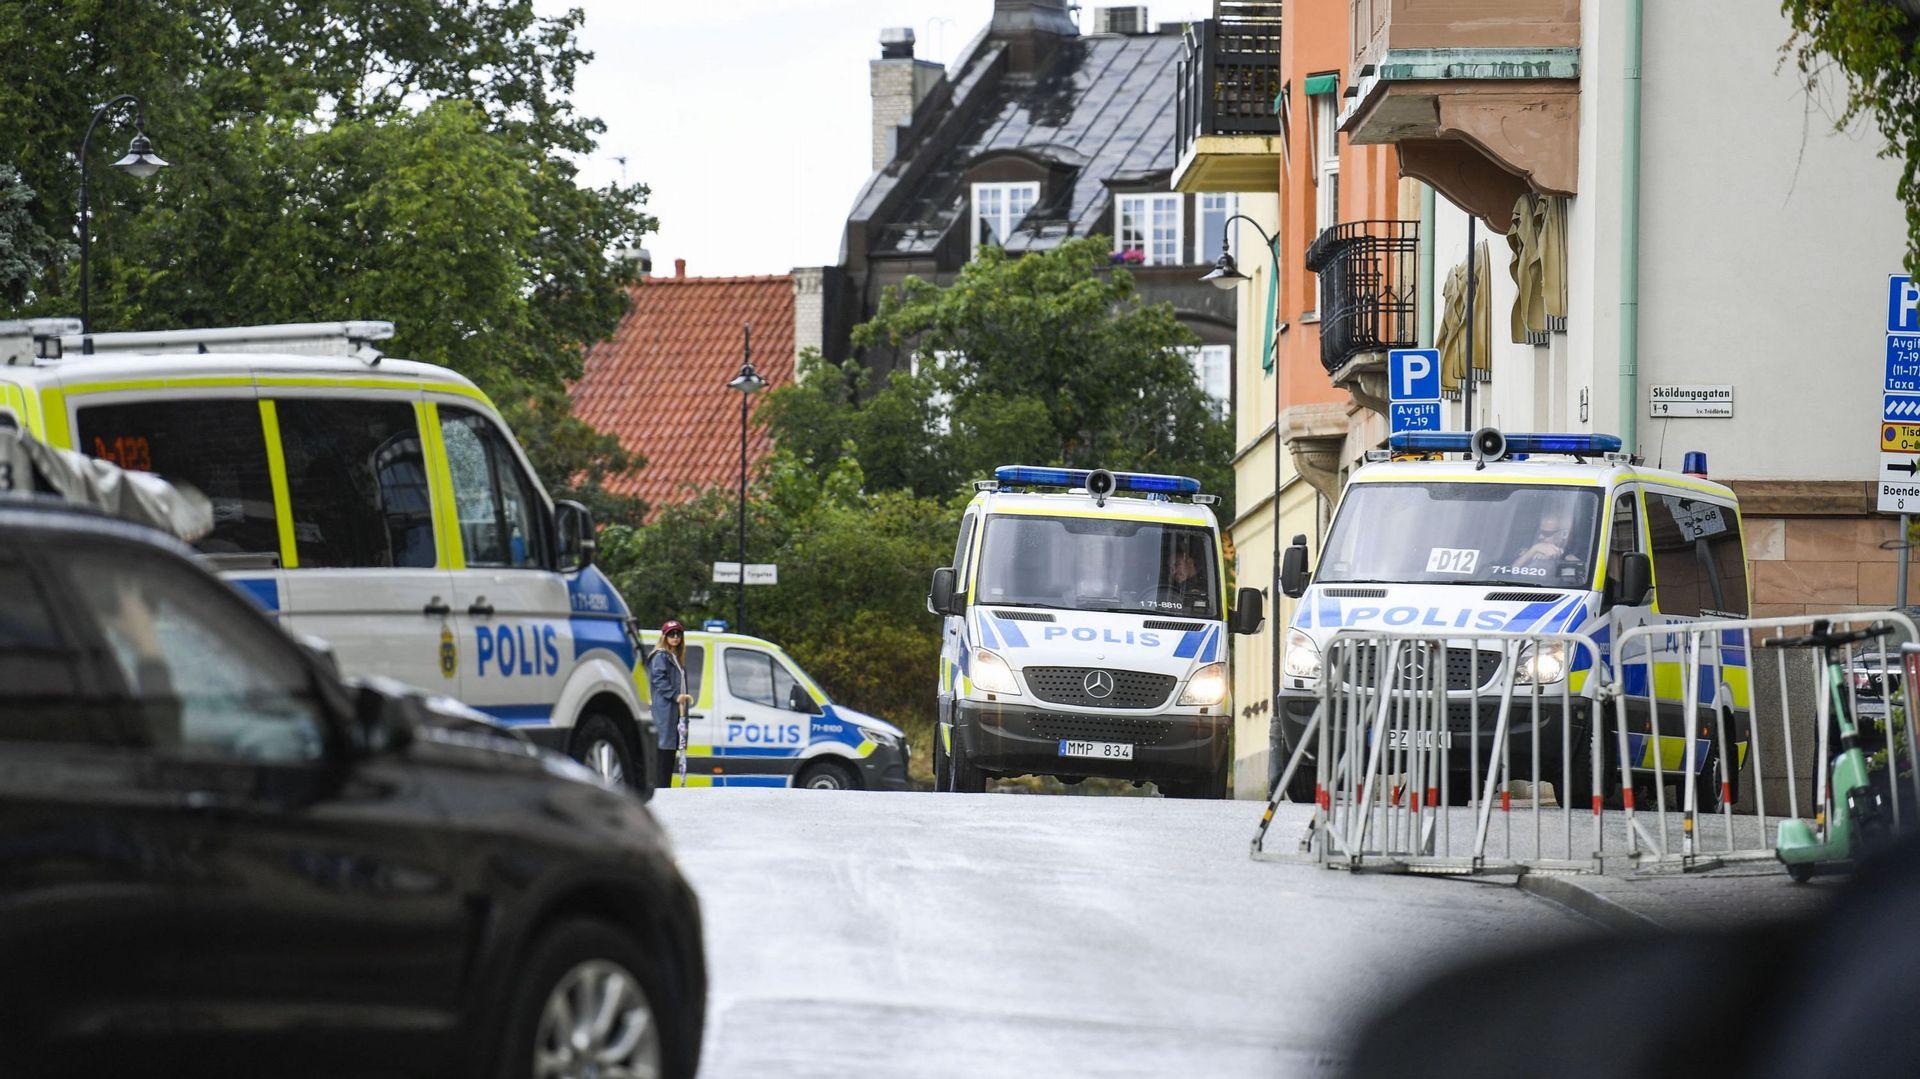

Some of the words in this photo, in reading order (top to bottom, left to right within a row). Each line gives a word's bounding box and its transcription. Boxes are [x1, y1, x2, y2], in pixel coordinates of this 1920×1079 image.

[1897, 352, 1919, 362] 7-19
[1402, 355, 1431, 396] P
[1888, 379, 1914, 389] Taxa
[1653, 387, 1730, 401] Sköldungagatan
[1397, 405, 1434, 416] Avgift
[1404, 417, 1428, 426] 7-19
[1901, 439, 1917, 449] 0-
[1883, 485, 1920, 496] Boende
[1897, 498, 1905, 509] Ö
[1436, 550, 1475, 573] D12
[1492, 565, 1547, 576] 71-8820
[1148, 601, 1183, 610] 71-8810
[1344, 606, 1507, 631] POLIS
[1044, 626, 1161, 647] POLIS
[476, 624, 560, 677] POLIS
[728, 724, 800, 743] POLIS
[1068, 742, 1094, 755] MMP
[1104, 744, 1129, 758] 834
